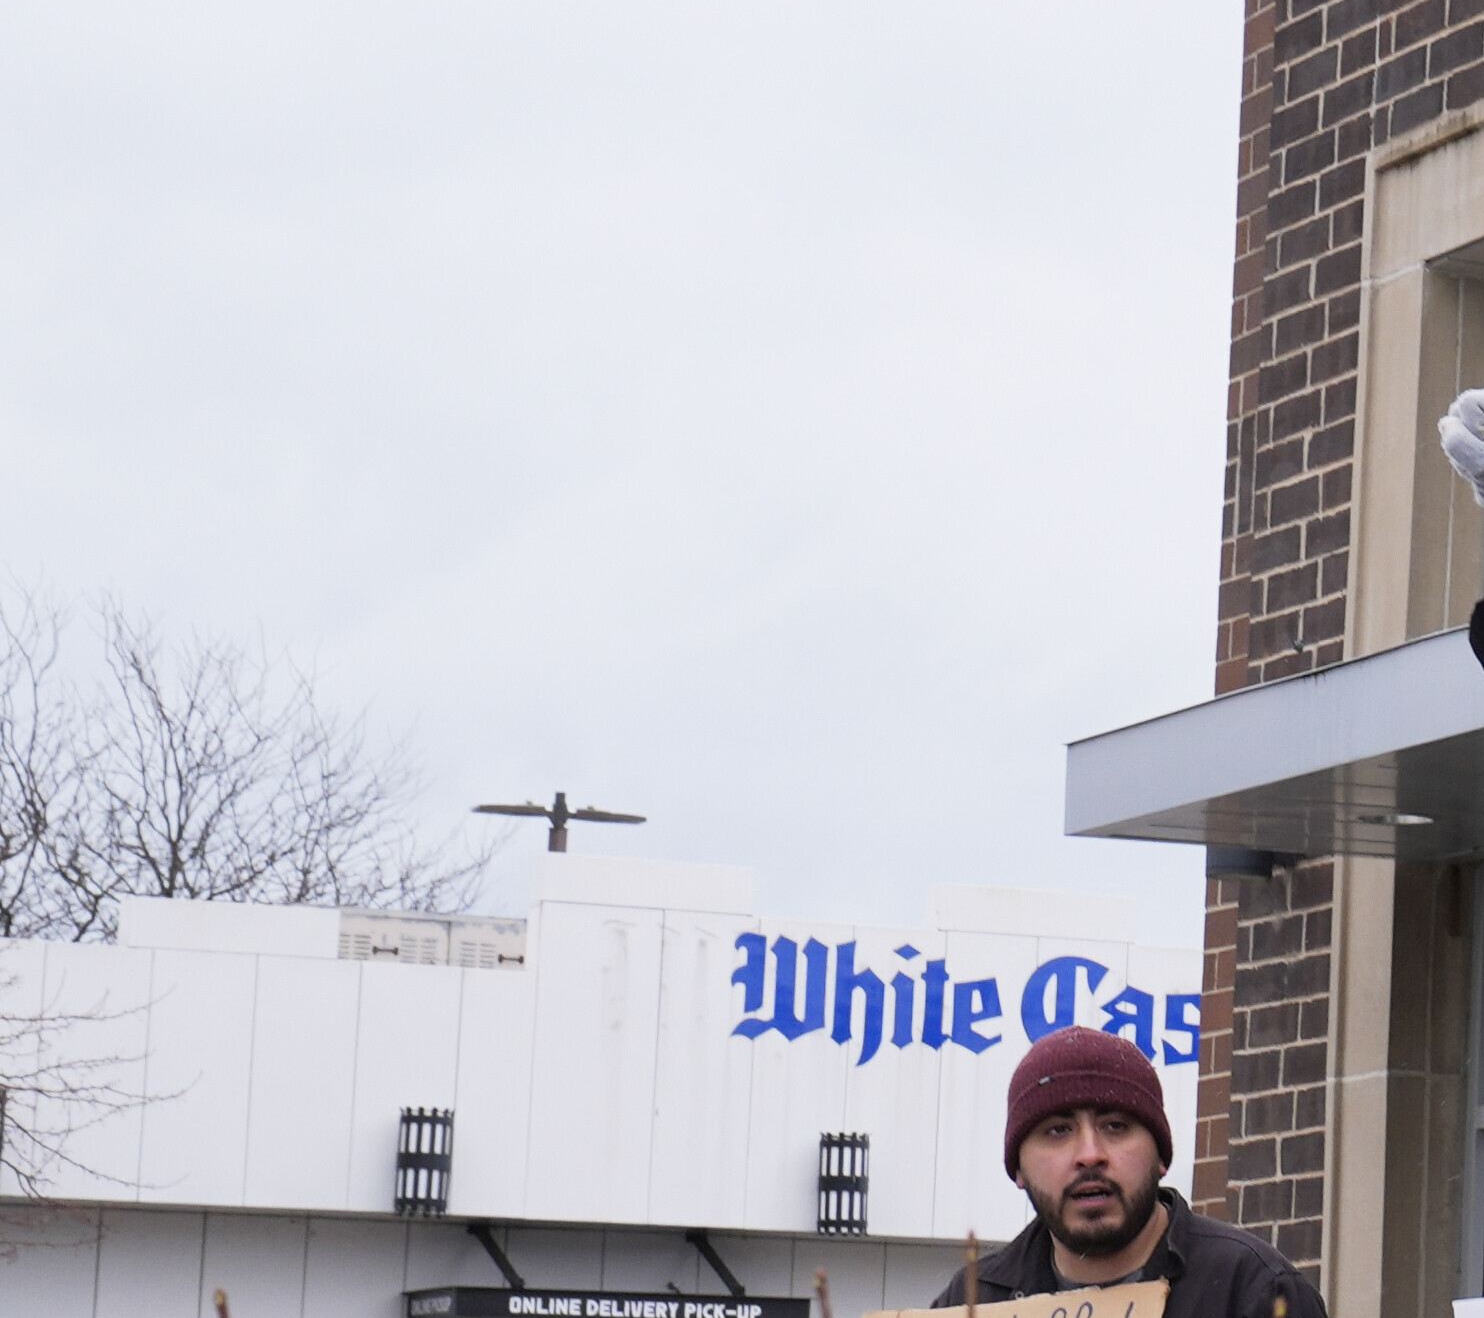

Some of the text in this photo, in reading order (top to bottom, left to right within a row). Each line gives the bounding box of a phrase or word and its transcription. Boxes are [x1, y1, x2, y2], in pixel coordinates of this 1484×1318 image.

[731, 932, 1002, 1066] White
[509, 1296, 582, 1316] ONLINE
[586, 1299, 679, 1318] DELIVERY
